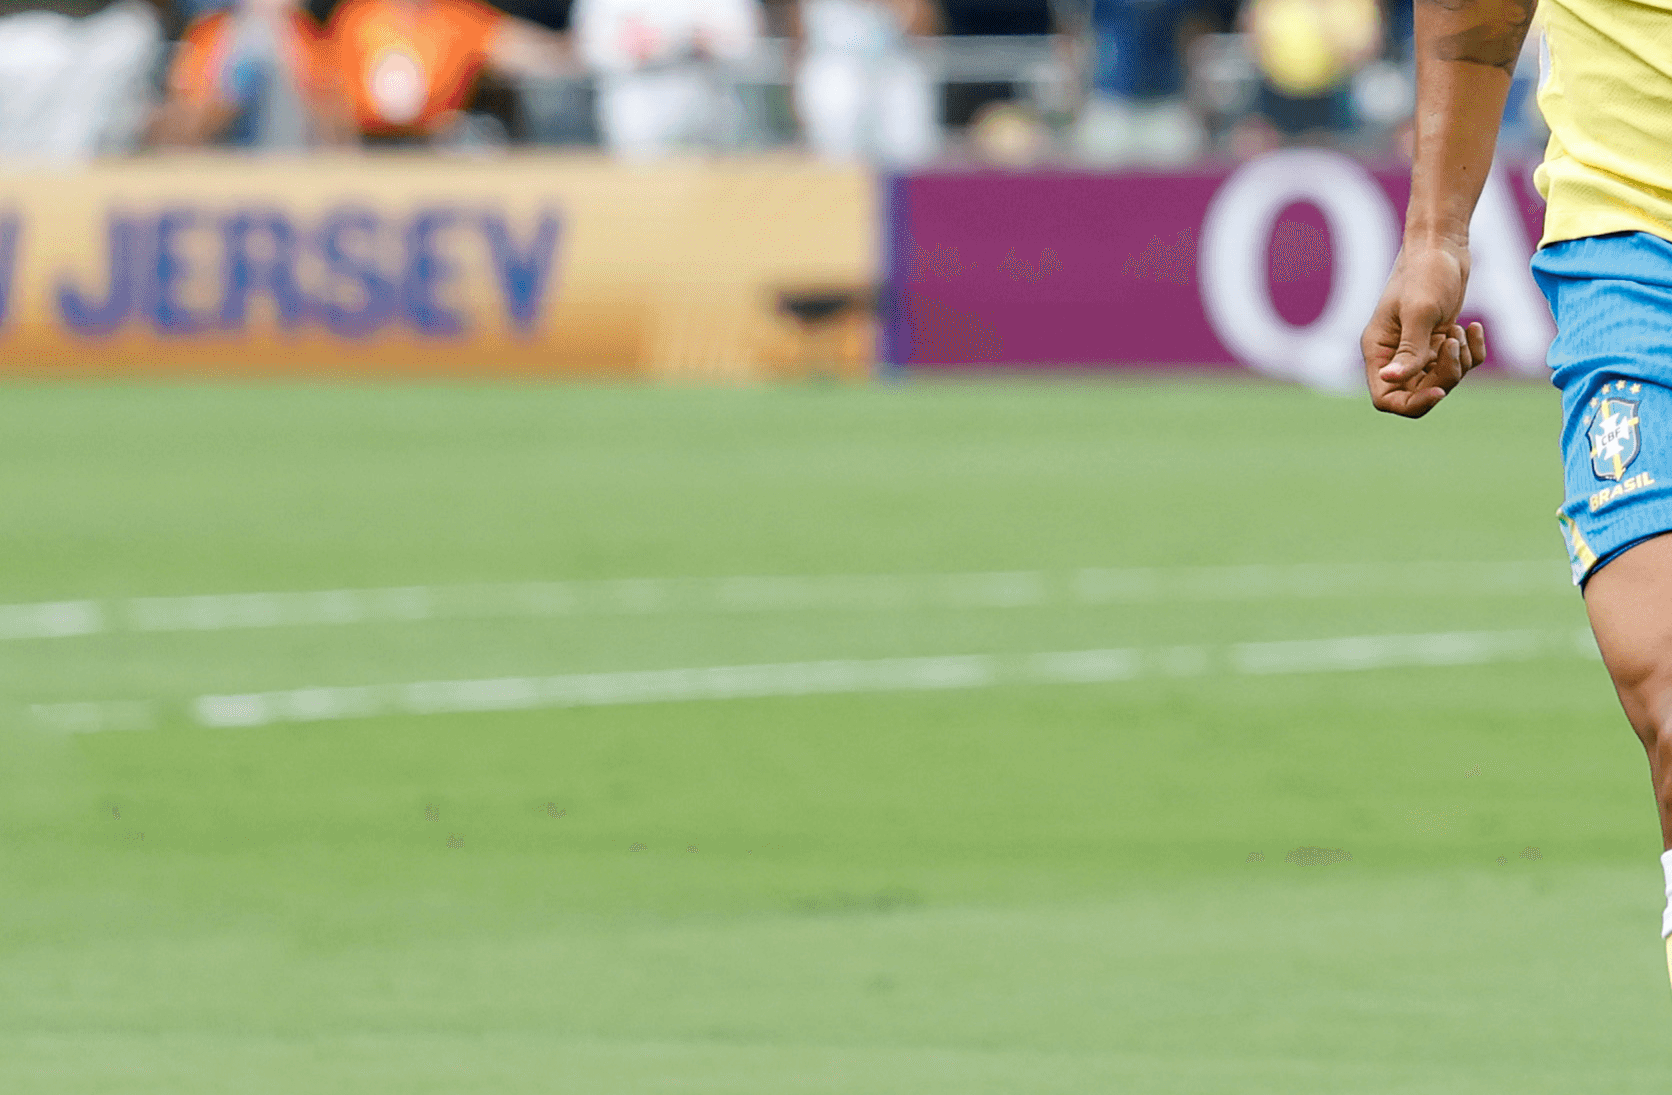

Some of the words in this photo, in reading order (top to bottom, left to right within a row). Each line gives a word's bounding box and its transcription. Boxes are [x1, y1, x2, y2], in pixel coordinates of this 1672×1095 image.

[52, 200, 564, 338] JERSEY
[1600, 426, 1622, 446] CBF
[1588, 471, 1656, 512] BRASIL
